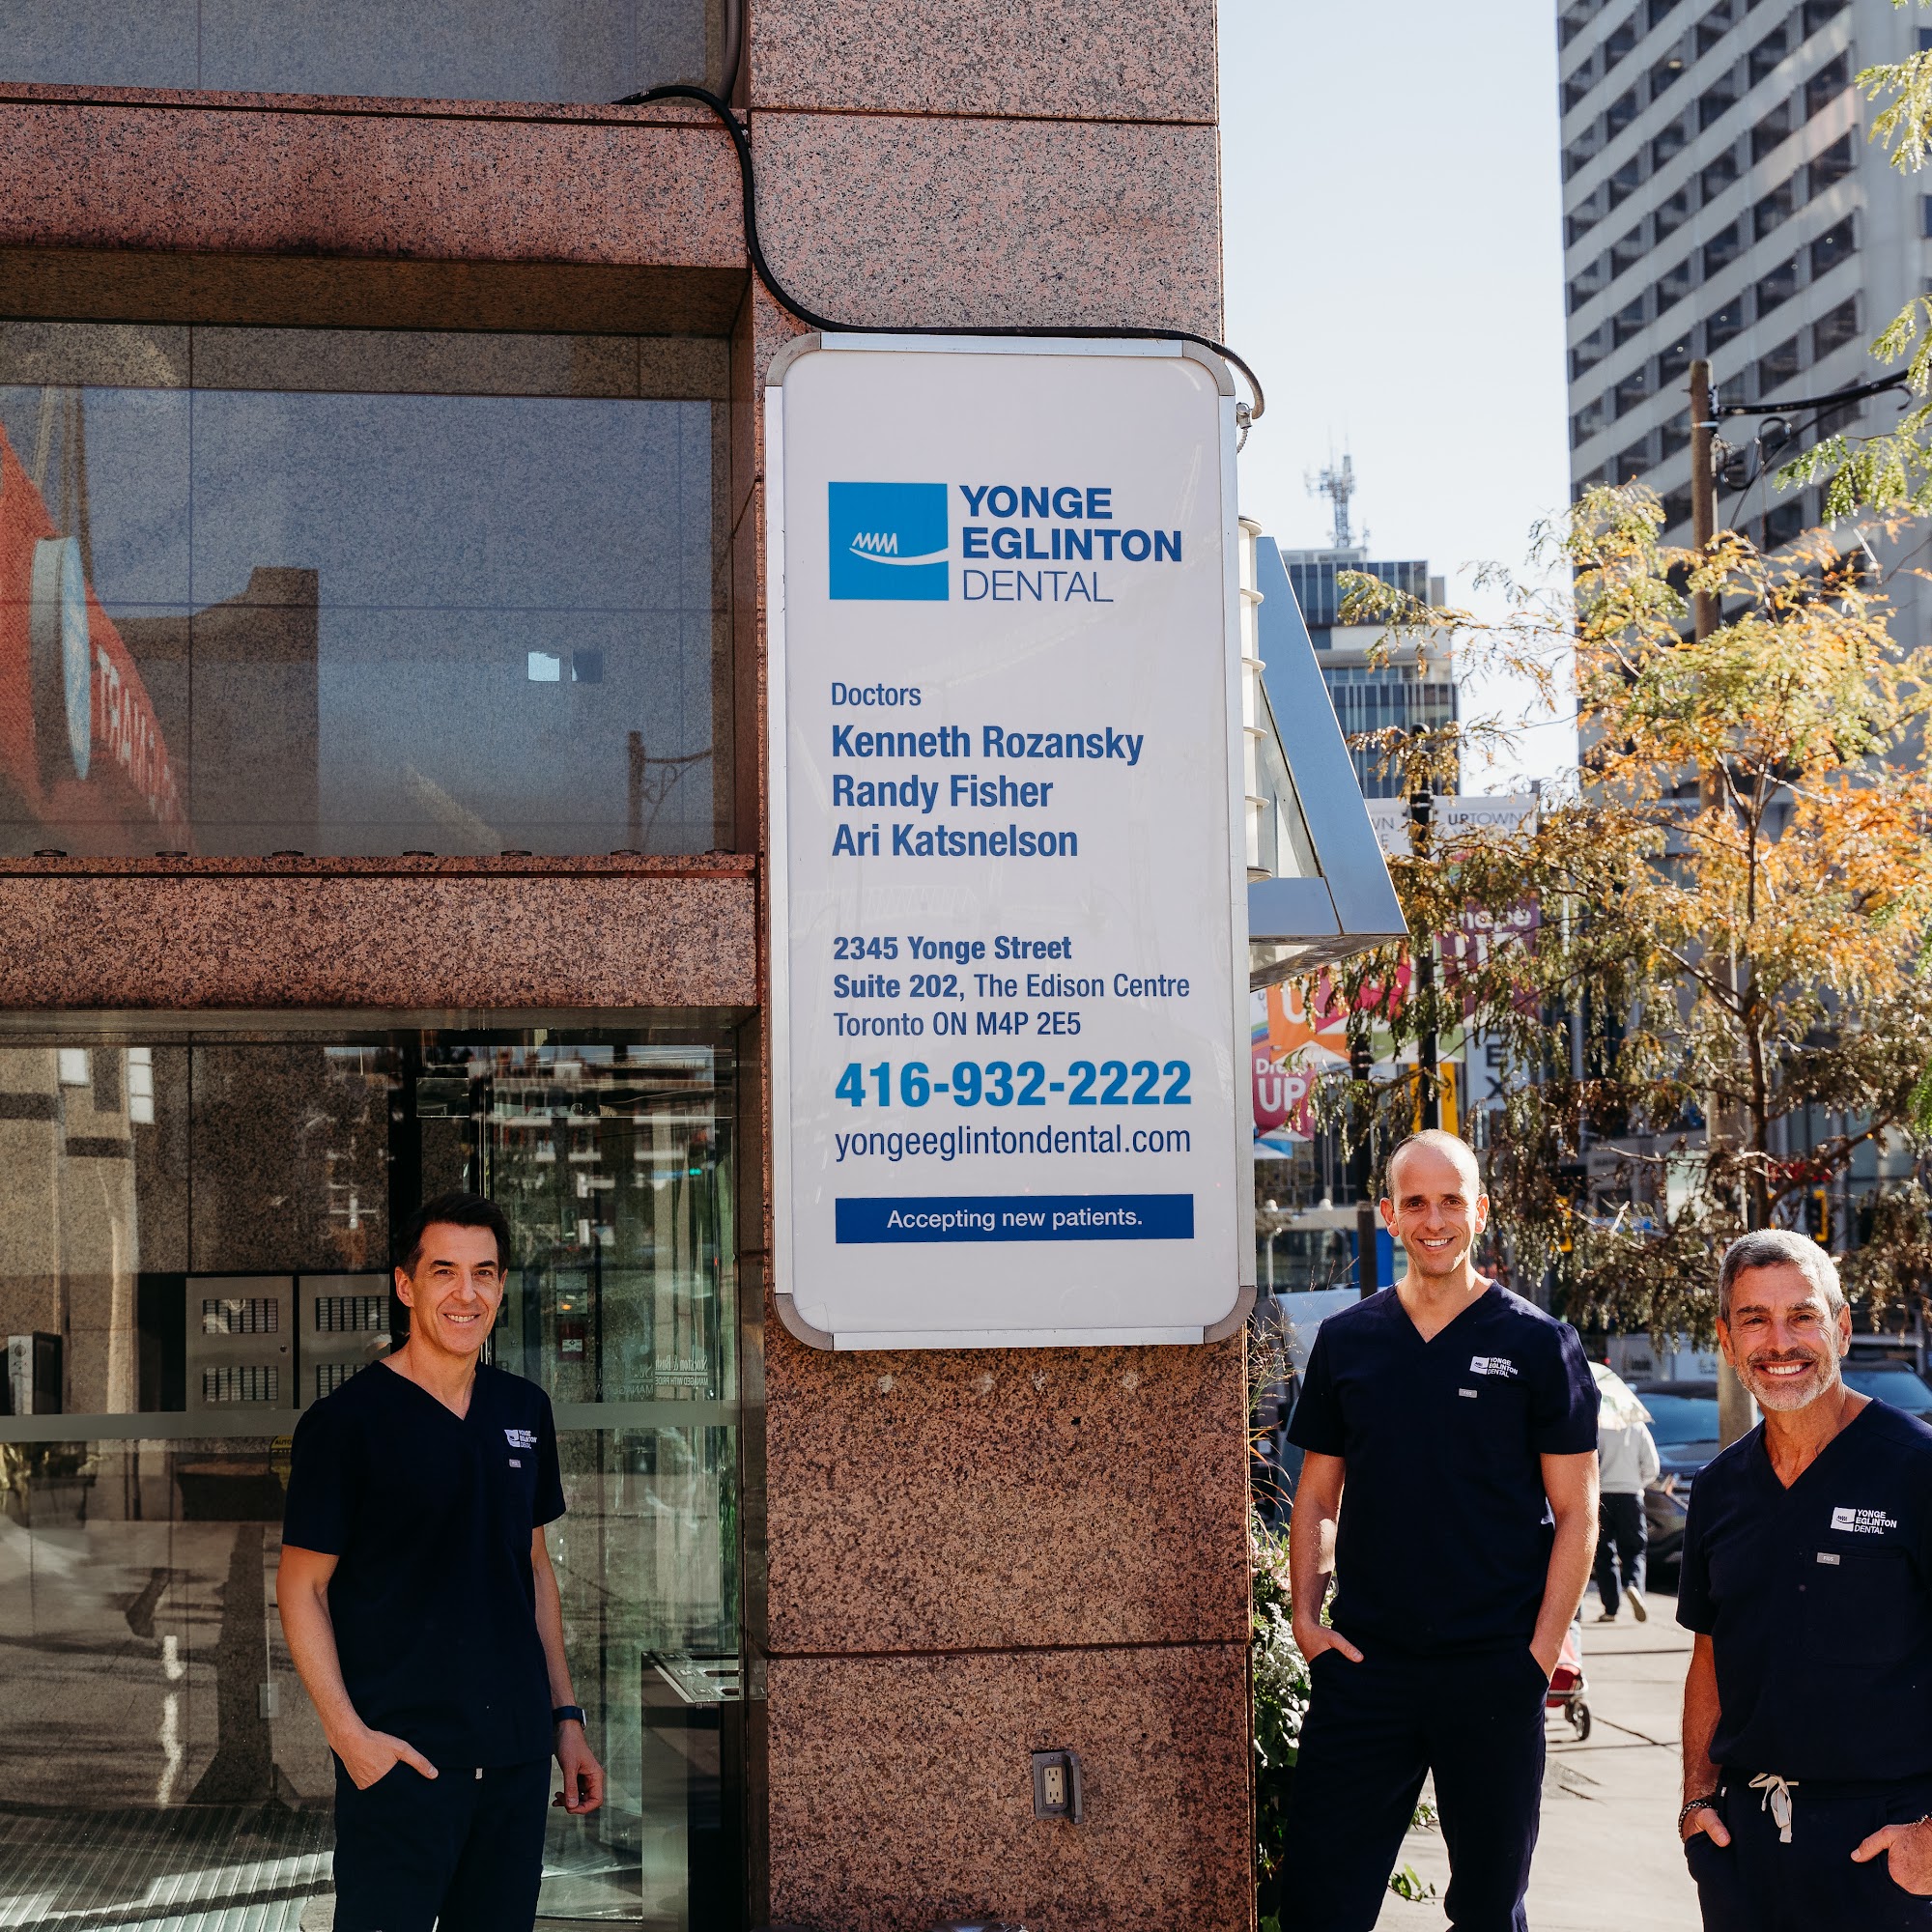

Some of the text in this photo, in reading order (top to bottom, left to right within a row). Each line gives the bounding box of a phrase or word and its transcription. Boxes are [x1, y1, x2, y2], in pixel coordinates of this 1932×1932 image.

[959, 485, 1113, 520] YONGE
[962, 526, 1182, 562] EGLINTON
[963, 569, 1114, 603] DENTAL
[831, 682, 922, 706] Doctors
[832, 724, 1145, 767] Kenneth Rozansky
[833, 774, 1054, 814] Randy Fisher
[1448, 812, 1522, 826] UPTOWN
[832, 823, 1078, 857] Ari Katsnelson
[833, 935, 1072, 965] 2345 Yonge Street
[834, 973, 1190, 1003] Suite 202, The Edison Centre
[833, 1011, 1081, 1037] Toronto ON M4P 2E5
[835, 1060, 1192, 1107] 416-932-2222
[1258, 1077, 1306, 1113] UP
[835, 1123, 1191, 1162] yongeeglintondental.com
[887, 1208, 1143, 1232] Accepting new patients.
[1488, 1369, 1509, 1378] DENTAL
[1489, 1363, 1518, 1375] EGLINTON
[1490, 1357, 1512, 1366] YONGE
[1854, 1524, 1884, 1534] DENTAL
[1855, 1517, 1897, 1528] EGLINTON
[1857, 1509, 1887, 1519] YONGE
